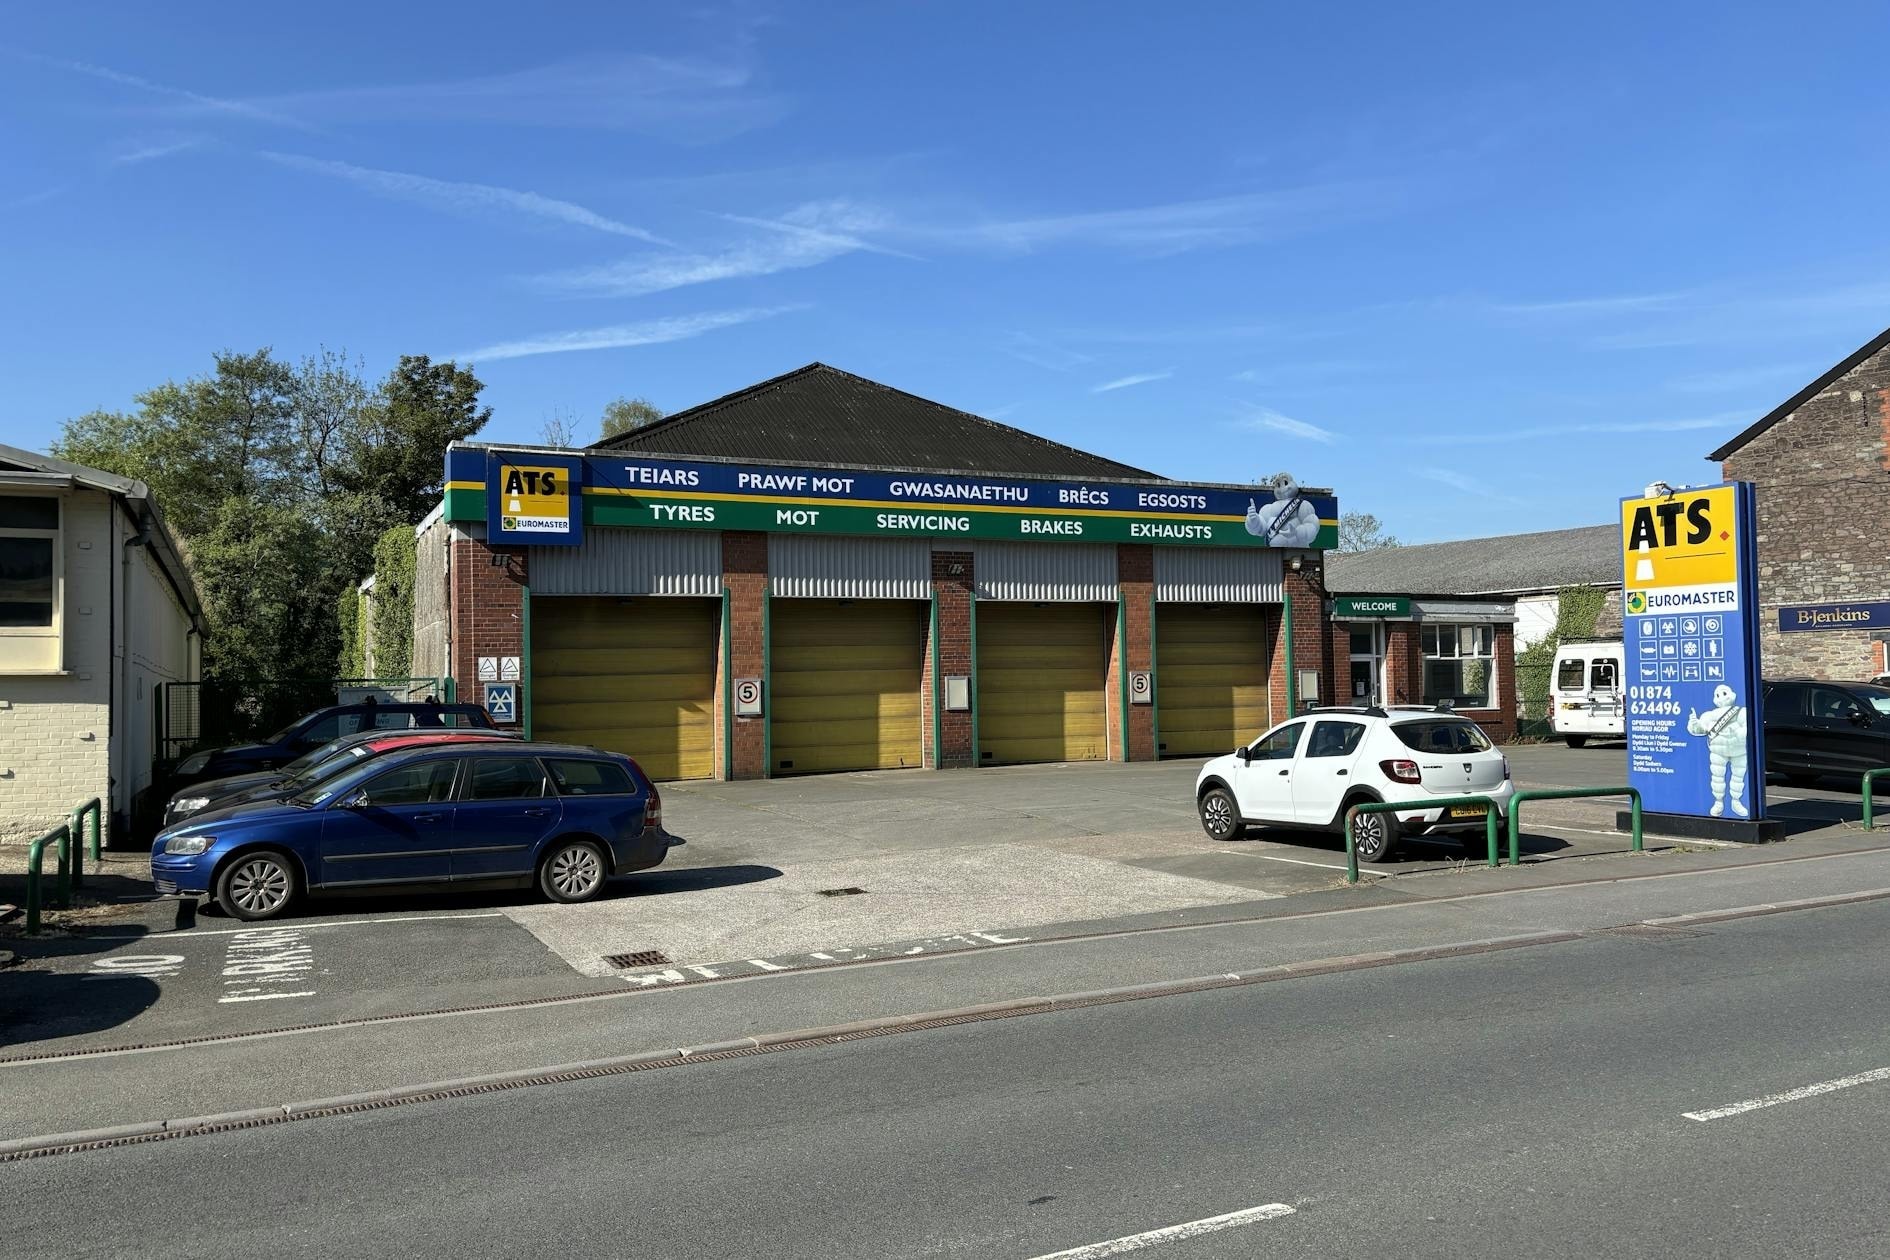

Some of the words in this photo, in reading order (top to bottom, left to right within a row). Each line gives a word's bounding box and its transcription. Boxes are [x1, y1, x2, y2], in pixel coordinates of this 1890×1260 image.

[505, 471, 556, 496] ATS
[625, 466, 699, 486] TEIARS
[738, 473, 807, 491] PRAWF
[812, 477, 854, 493] MOT
[889, 481, 1029, 501] GWASANAETHU
[1059, 487, 1109, 505] BRÊCS
[1138, 493, 1207, 509] EGSOSTS
[517, 520, 568, 529] EUROMASTER
[649, 504, 715, 522] TYRES
[776, 510, 820, 525] MOT
[876, 514, 970, 531] SERVICING
[1020, 519, 1083, 535] BRAKES
[1130, 523, 1212, 539] EXHAUSTS
[1629, 498, 1712, 551] ATS
[1648, 590, 1735, 607] EUROMASTER
[1352, 602, 1397, 611] WELCOME
[1136, 678, 1144, 689] 5
[743, 686, 752, 699] 5
[1630, 686, 1672, 699] 01874
[1631, 701, 1681, 715] 624496
